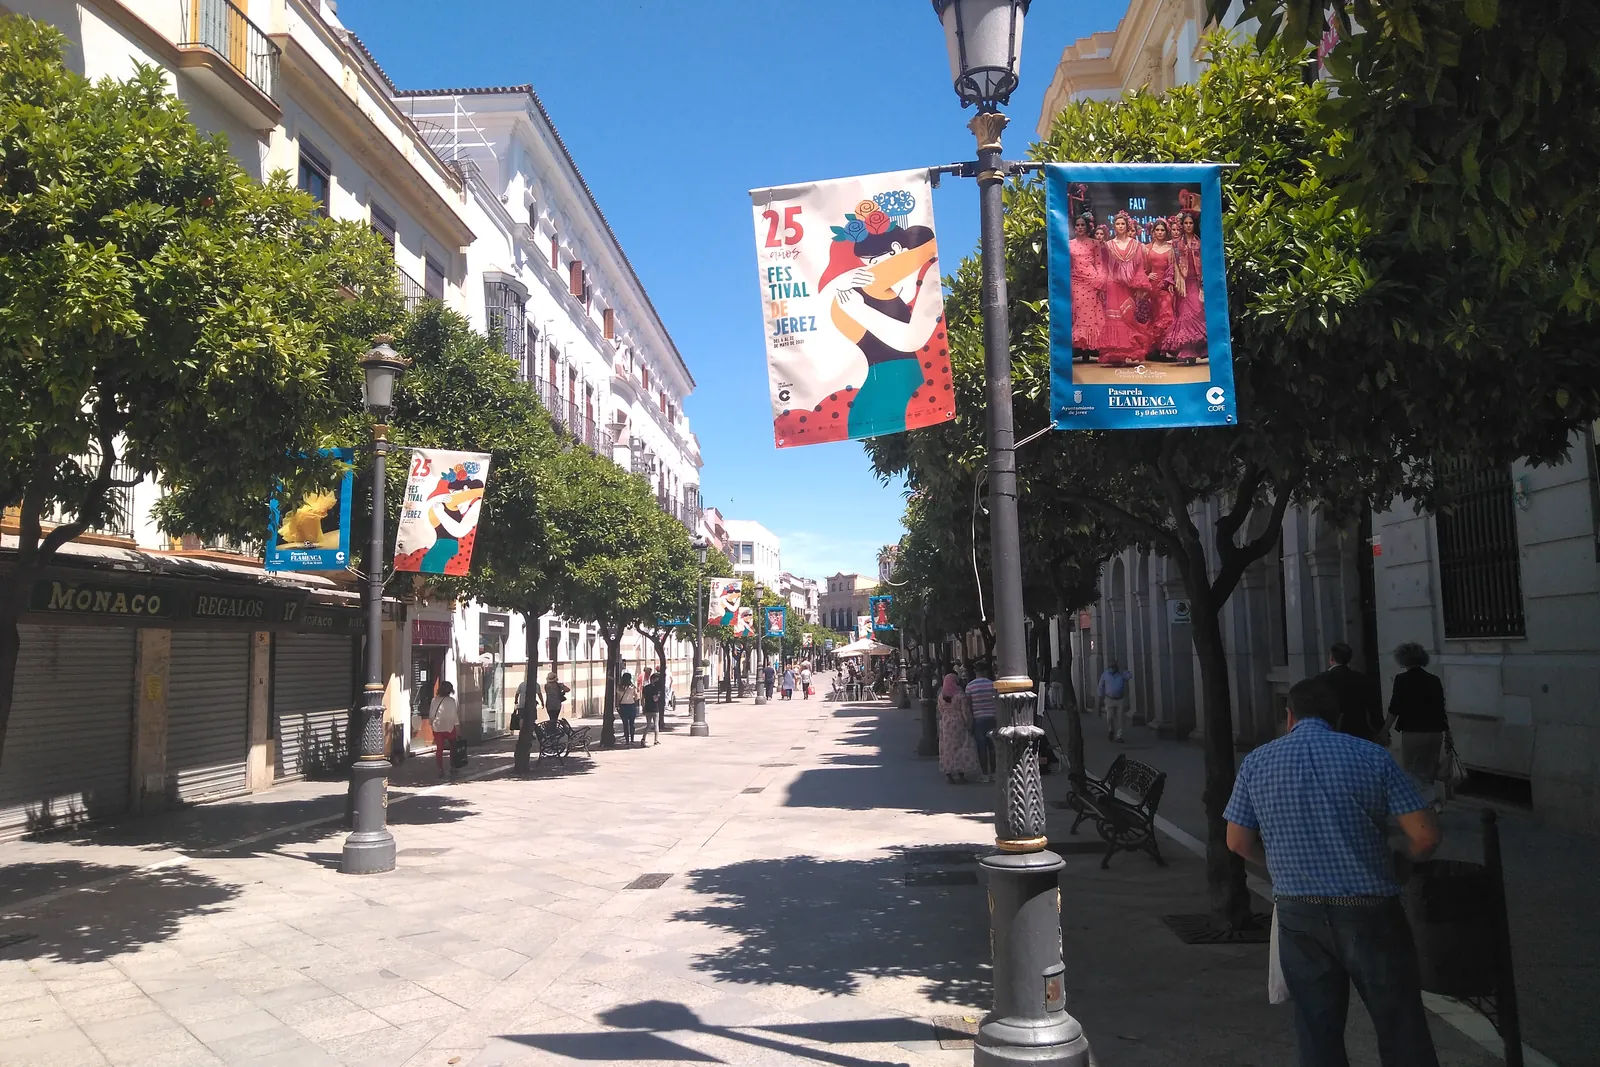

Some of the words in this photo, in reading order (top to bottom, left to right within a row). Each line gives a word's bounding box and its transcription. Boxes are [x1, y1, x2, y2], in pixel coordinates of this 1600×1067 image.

[1129, 197, 1146, 210] FALY
[761, 205, 804, 248] 25
[767, 266, 793, 283] FES
[769, 282, 810, 300] TIVAL
[770, 301, 789, 319] DE
[773, 316, 818, 336] JEREZ
[1108, 388, 1142, 396] Pasarela
[1108, 396, 1175, 407] FLAMENCA
[412, 458, 432, 477] 25
[48, 581, 161, 614] MONACO
[196, 596, 264, 618] REGALOS
[284, 602, 298, 621] 17
